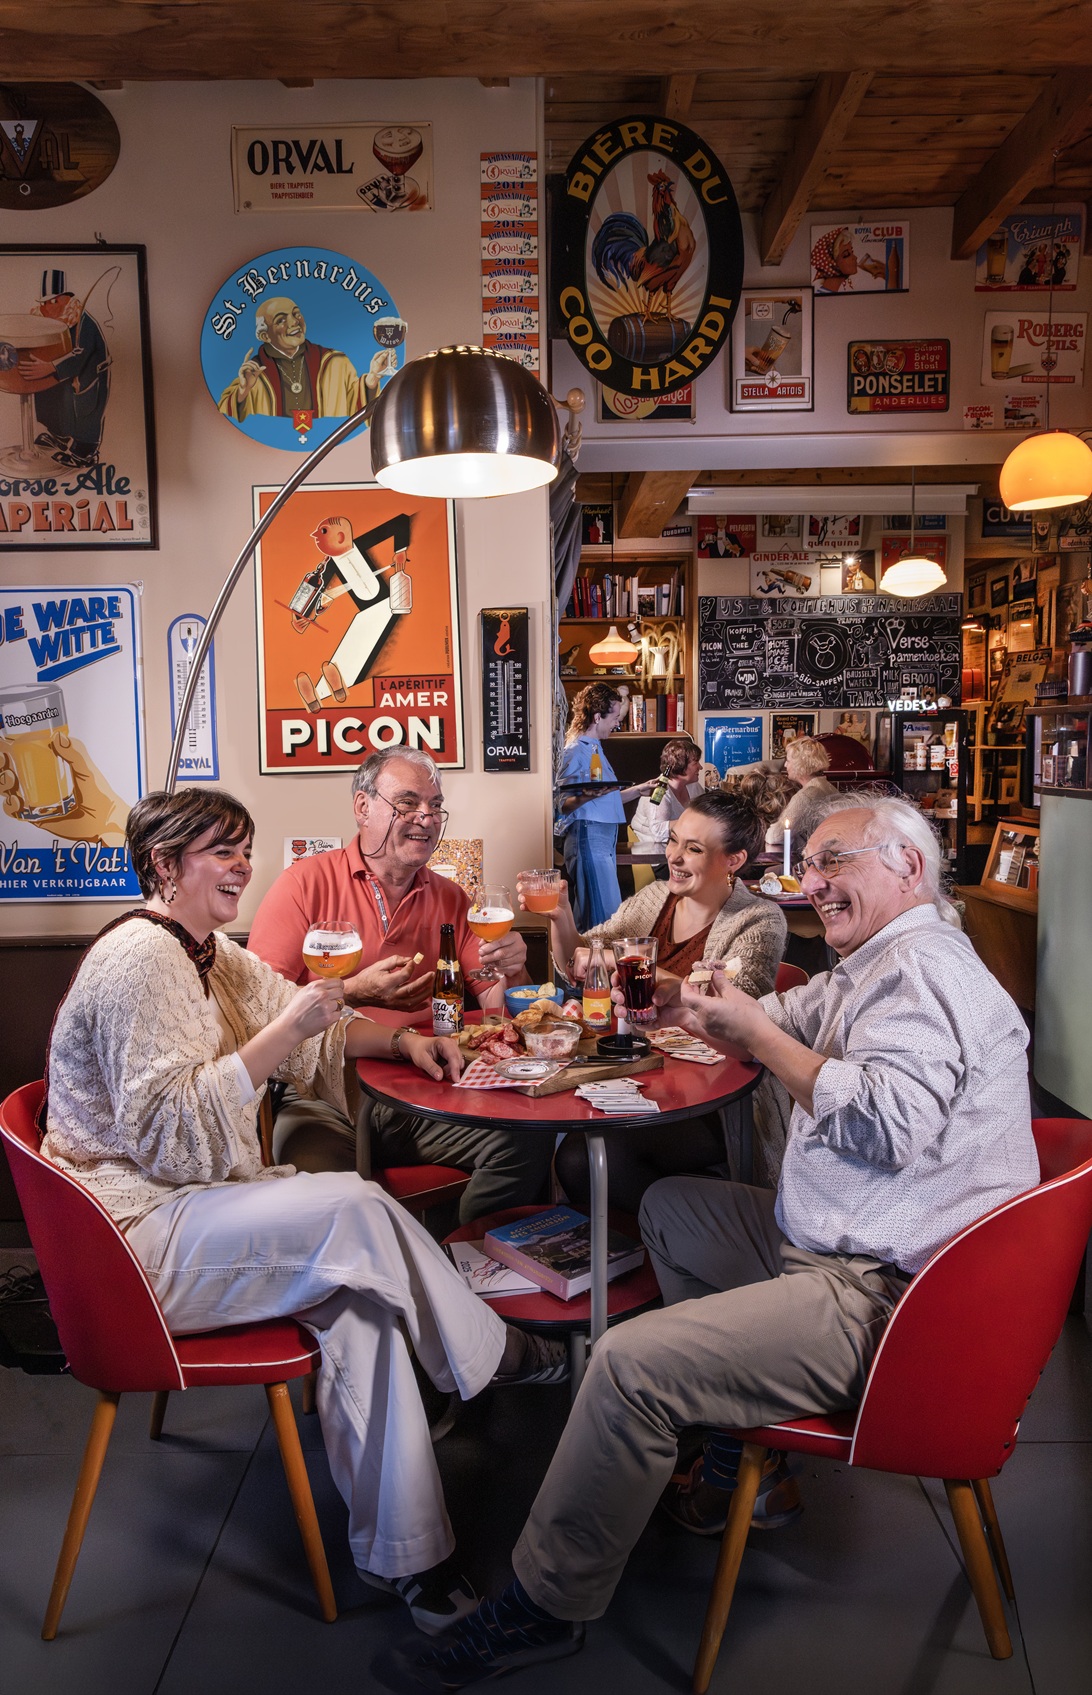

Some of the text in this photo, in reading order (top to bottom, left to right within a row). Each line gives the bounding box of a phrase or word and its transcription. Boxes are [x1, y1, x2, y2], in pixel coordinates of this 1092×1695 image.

[0, 120, 80, 179] VAL
[247, 139, 354, 175] ORVAL
[567, 121, 728, 205] BIÈRE DU
[493, 181, 524, 189] 2014
[493, 220, 524, 228] 2015
[873, 226, 903, 238] CLUB
[495, 258, 525, 266] 2016
[210, 259, 388, 340] St. Bernardus
[495, 295, 525, 304] 2017
[496, 332, 526, 341] 2018
[560, 286, 733, 391] COQ HARDI
[1017, 319, 1084, 347] ROBERG
[1045, 339, 1078, 351] PILS
[914, 353, 941, 362] Belge
[914, 361, 939, 370] Stout
[853, 374, 946, 395] PONSELET
[743, 386, 803, 397] STELLA ARTOIS
[874, 396, 945, 406] ANDERLUES
[776, 597, 858, 614] KOFFIEHUIS
[32, 596, 123, 632] WARE
[729, 627, 753, 635] KOFFIE
[887, 625, 930, 650] Verse
[27, 621, 118, 668] WITTE
[701, 642, 723, 651] PICON
[768, 639, 789, 650] HOME
[768, 655, 789, 665] ICE
[888, 649, 960, 667] pannenkoeken
[738, 673, 755, 684] WIJN
[883, 670, 899, 680] MILK
[902, 673, 935, 684] BROOD
[380, 677, 446, 691] L'APÉRITIF
[848, 679, 873, 688] WAFELS
[763, 686, 785, 699] SINGLE
[847, 689, 884, 707] TAPA'S
[379, 691, 449, 708] AMER
[5, 707, 60, 728] Hoegaarden
[720, 725, 760, 733] Bernardus
[281, 715, 445, 757] PICON
[486, 746, 527, 756] ORVAL
[178, 757, 211, 770] ORVAL
[0, 839, 42, 876] Van
[70, 839, 129, 875] Vat!
[0, 878, 127, 889] HIER VERKRIJGBAAR
